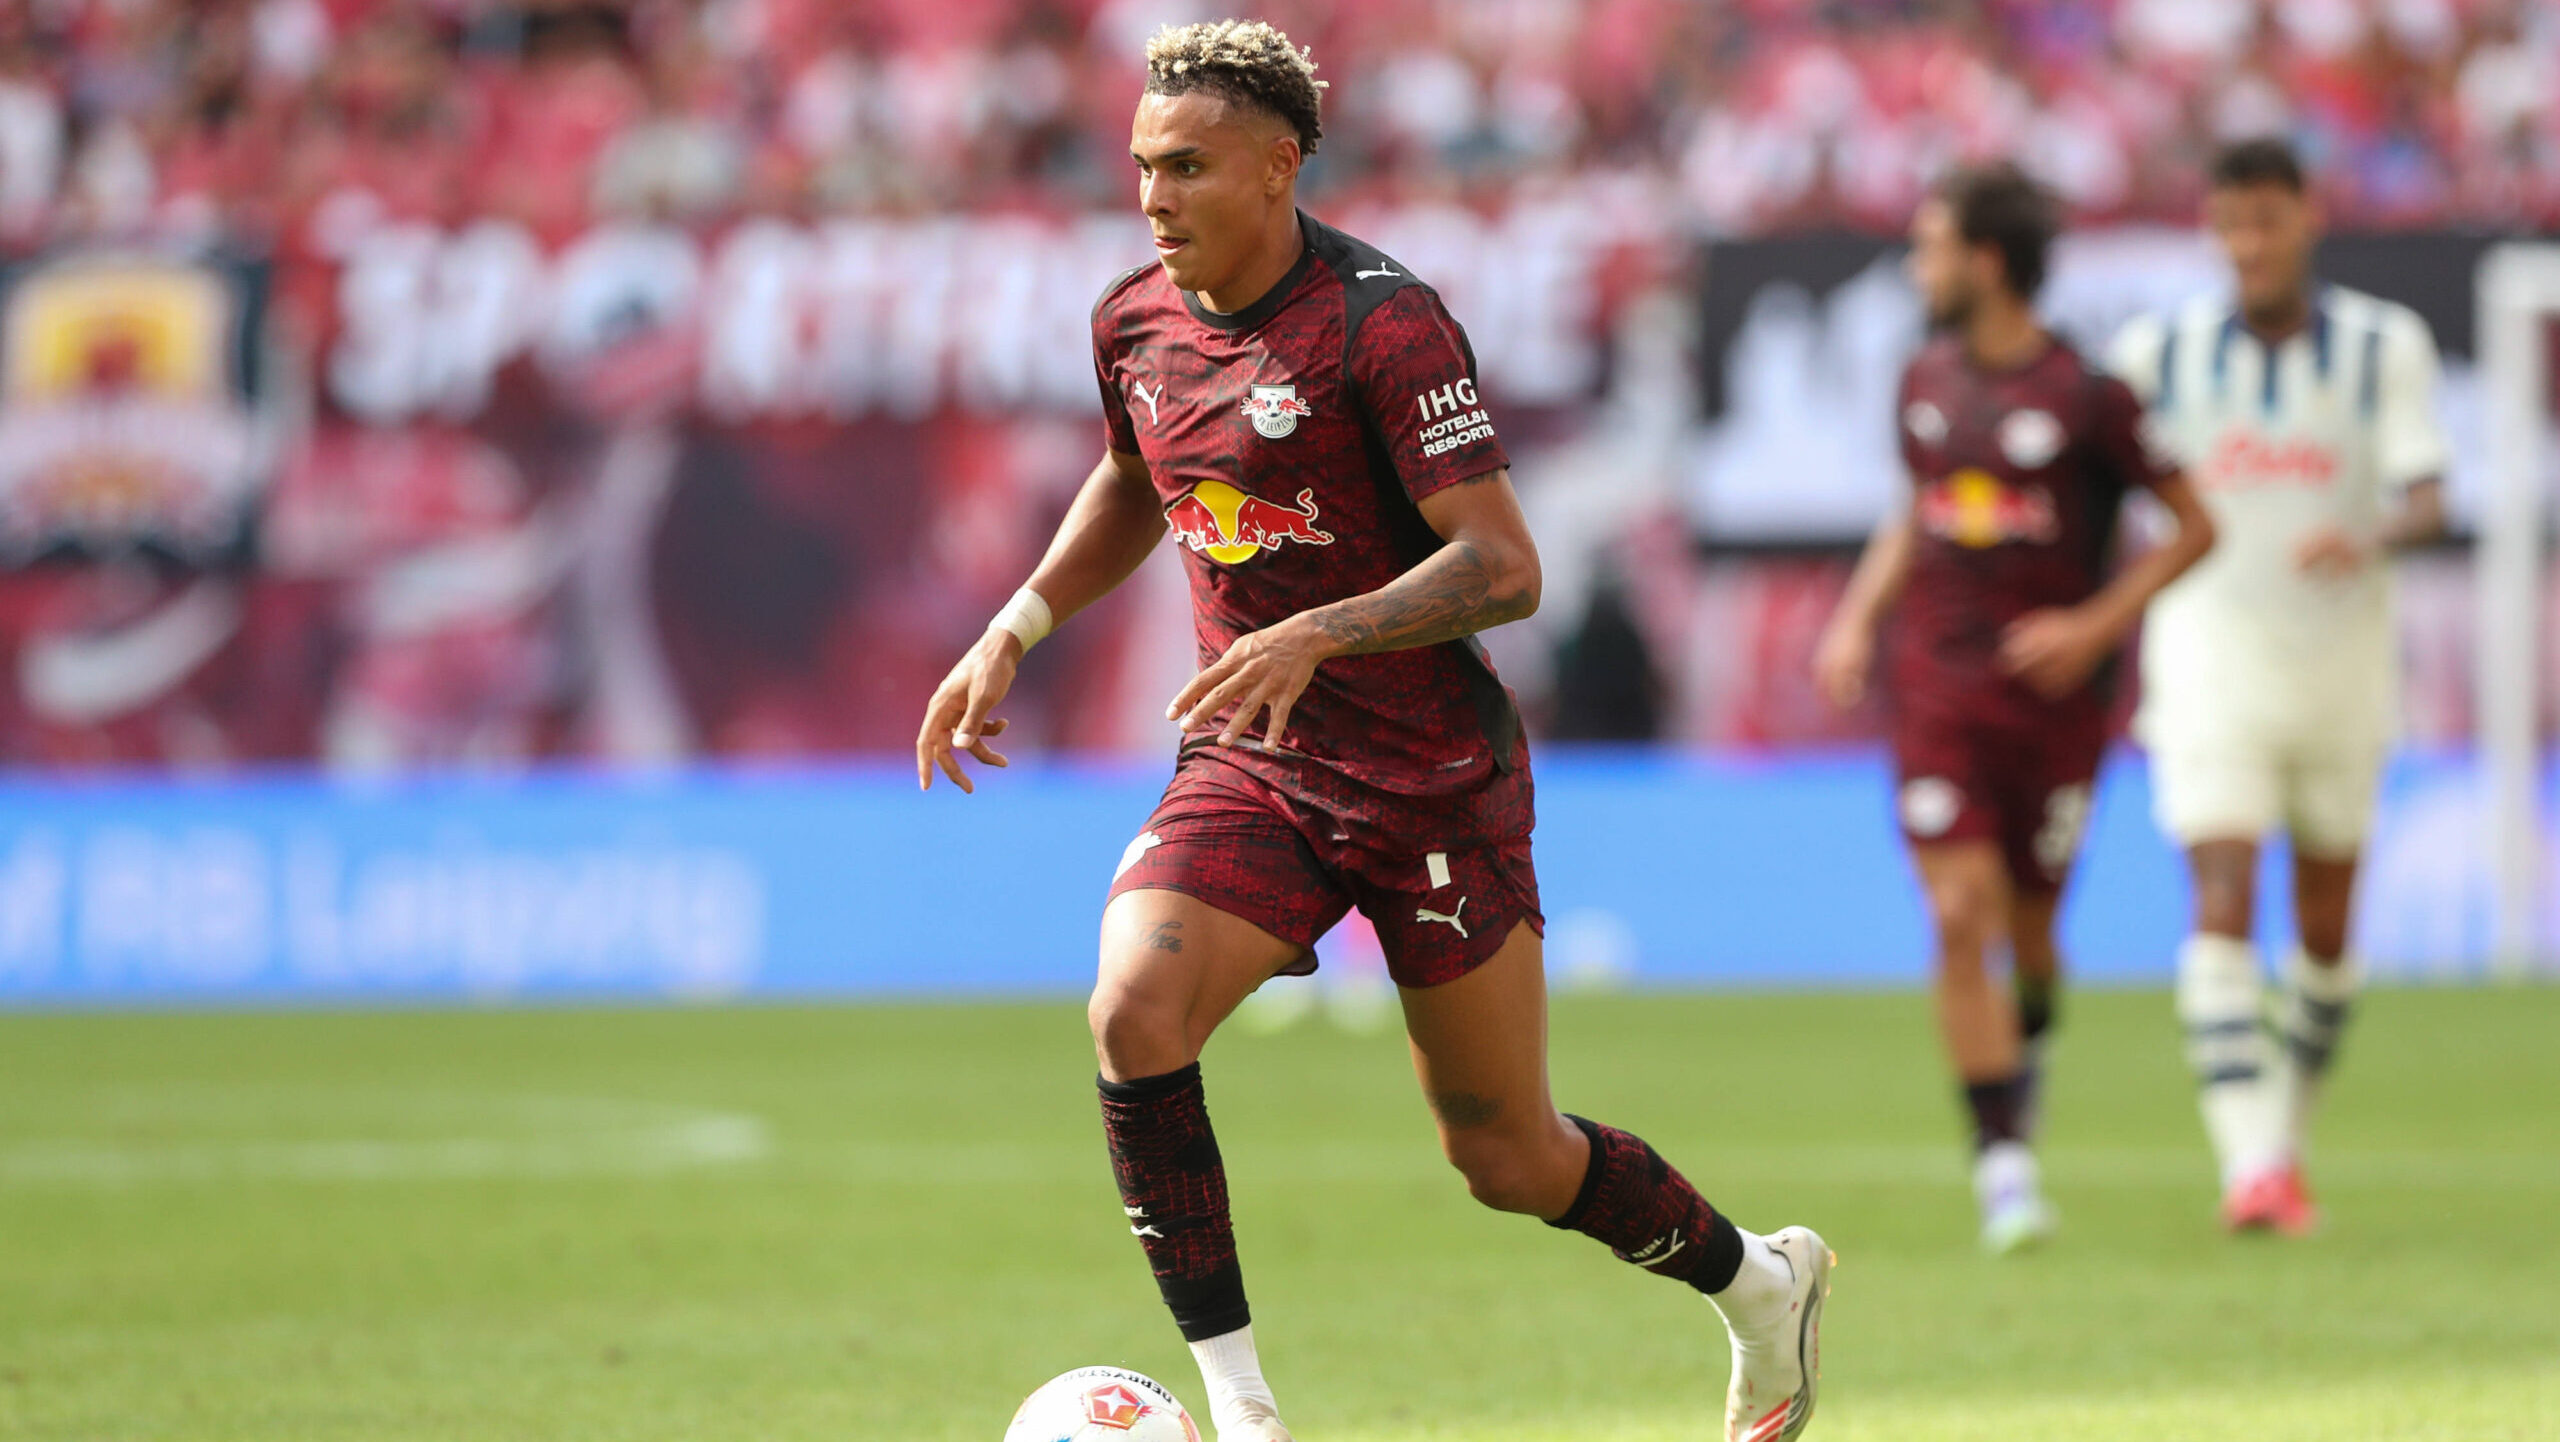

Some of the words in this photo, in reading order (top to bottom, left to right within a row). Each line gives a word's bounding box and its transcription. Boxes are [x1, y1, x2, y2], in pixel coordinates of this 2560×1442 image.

[1417, 377, 1478, 422] IHG
[1419, 411, 1481, 443] HOTELS
[1423, 424, 1495, 458] RESORTS
